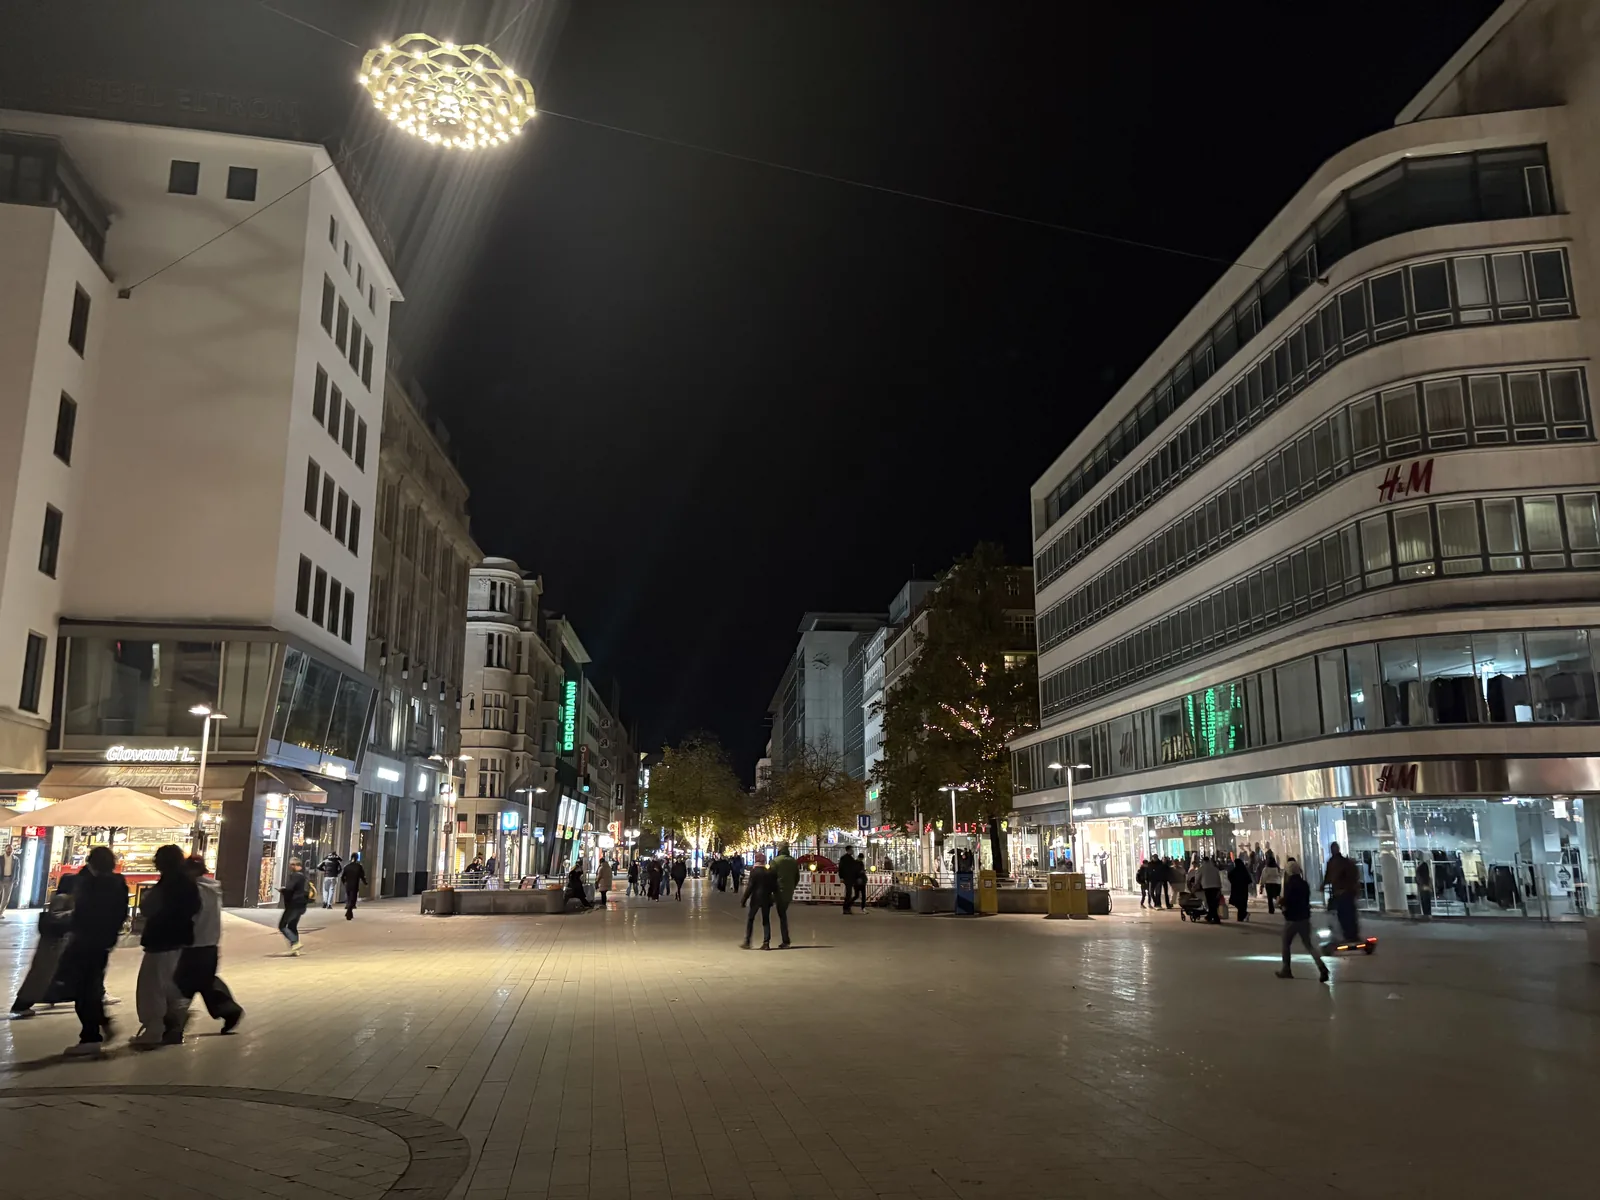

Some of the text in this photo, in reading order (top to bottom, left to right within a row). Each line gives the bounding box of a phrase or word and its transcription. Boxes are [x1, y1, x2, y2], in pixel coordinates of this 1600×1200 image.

[1377, 458, 1434, 503] H&M
[564, 681, 577, 751] DEICHMANN
[106, 745, 179, 762] Giovanni
[506, 814, 515, 828] U
[860, 816, 869, 828] U
[954, 822, 988, 833] GISY
